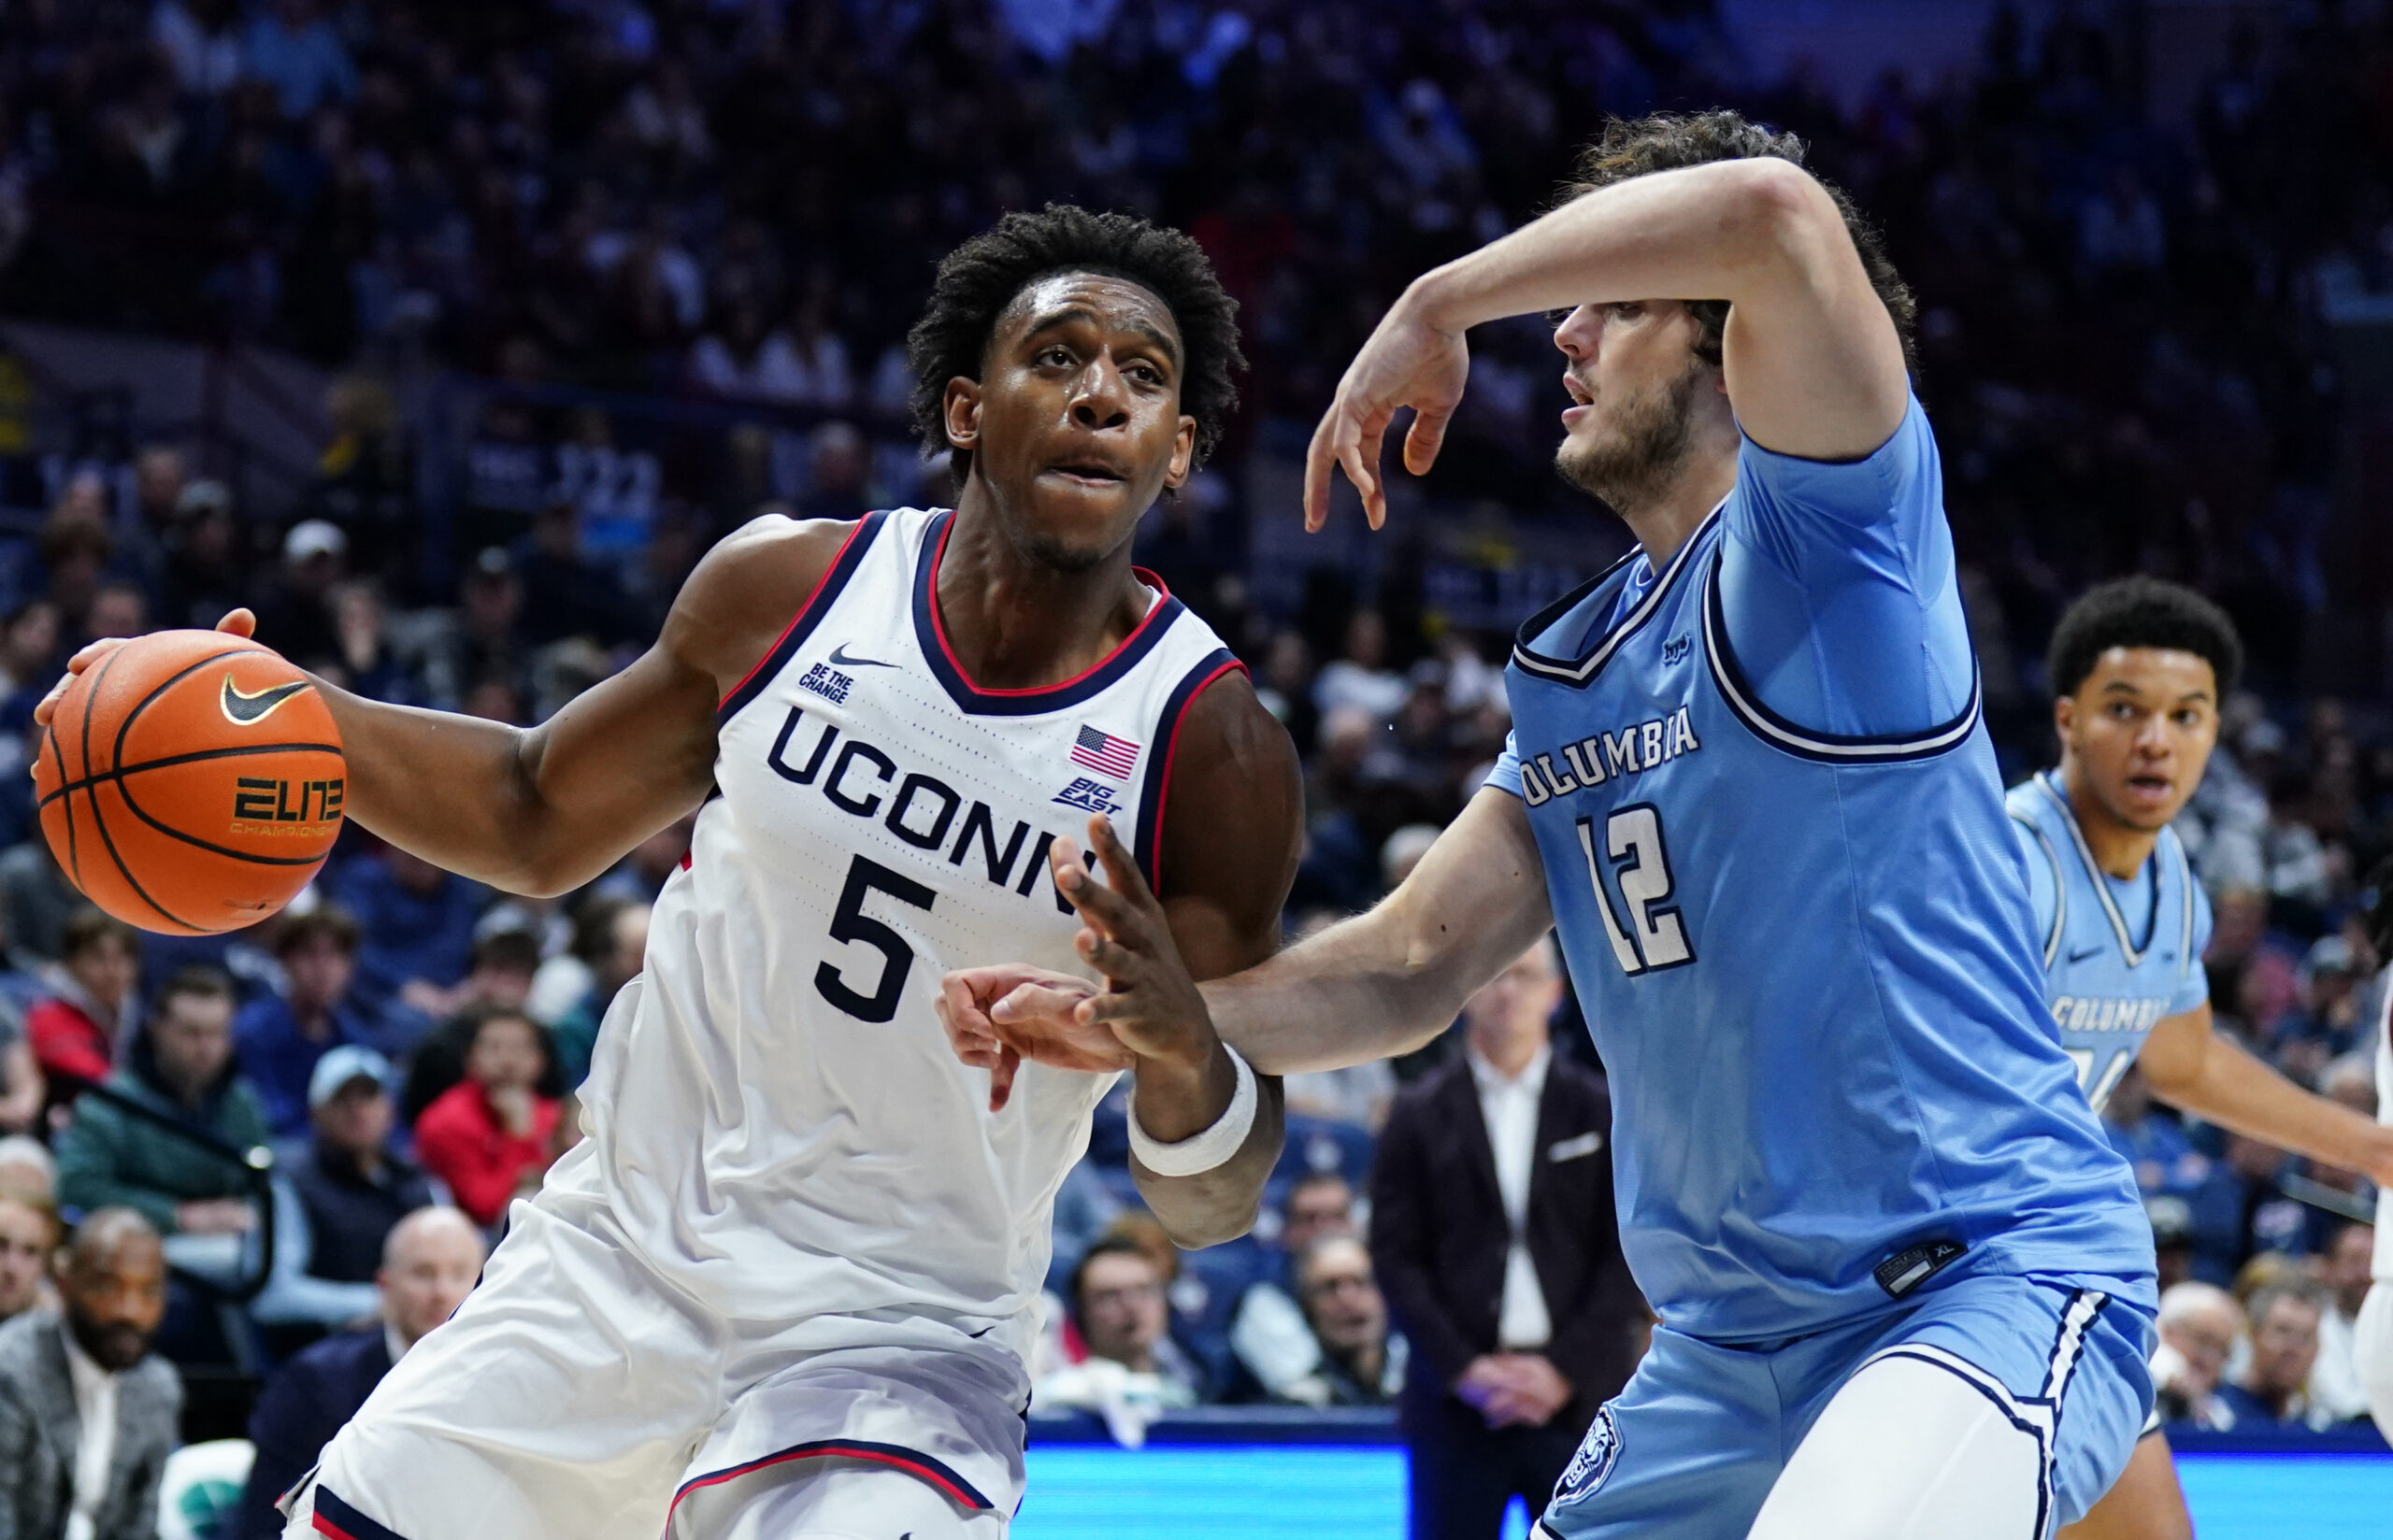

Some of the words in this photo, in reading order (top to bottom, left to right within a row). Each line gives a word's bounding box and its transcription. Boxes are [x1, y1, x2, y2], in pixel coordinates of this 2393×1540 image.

[798, 673, 849, 705] CHANGE
[810, 663, 830, 678] BE
[828, 670, 854, 691] THE
[1520, 705, 1699, 807] OLUMBIA
[234, 777, 344, 821] ELITE
[1058, 787, 1124, 815] EAST
[1069, 777, 1118, 799] BIG
[1576, 801, 1698, 978] 12
[813, 853, 939, 1023] 5
[1934, 1244, 1956, 1258] XL
